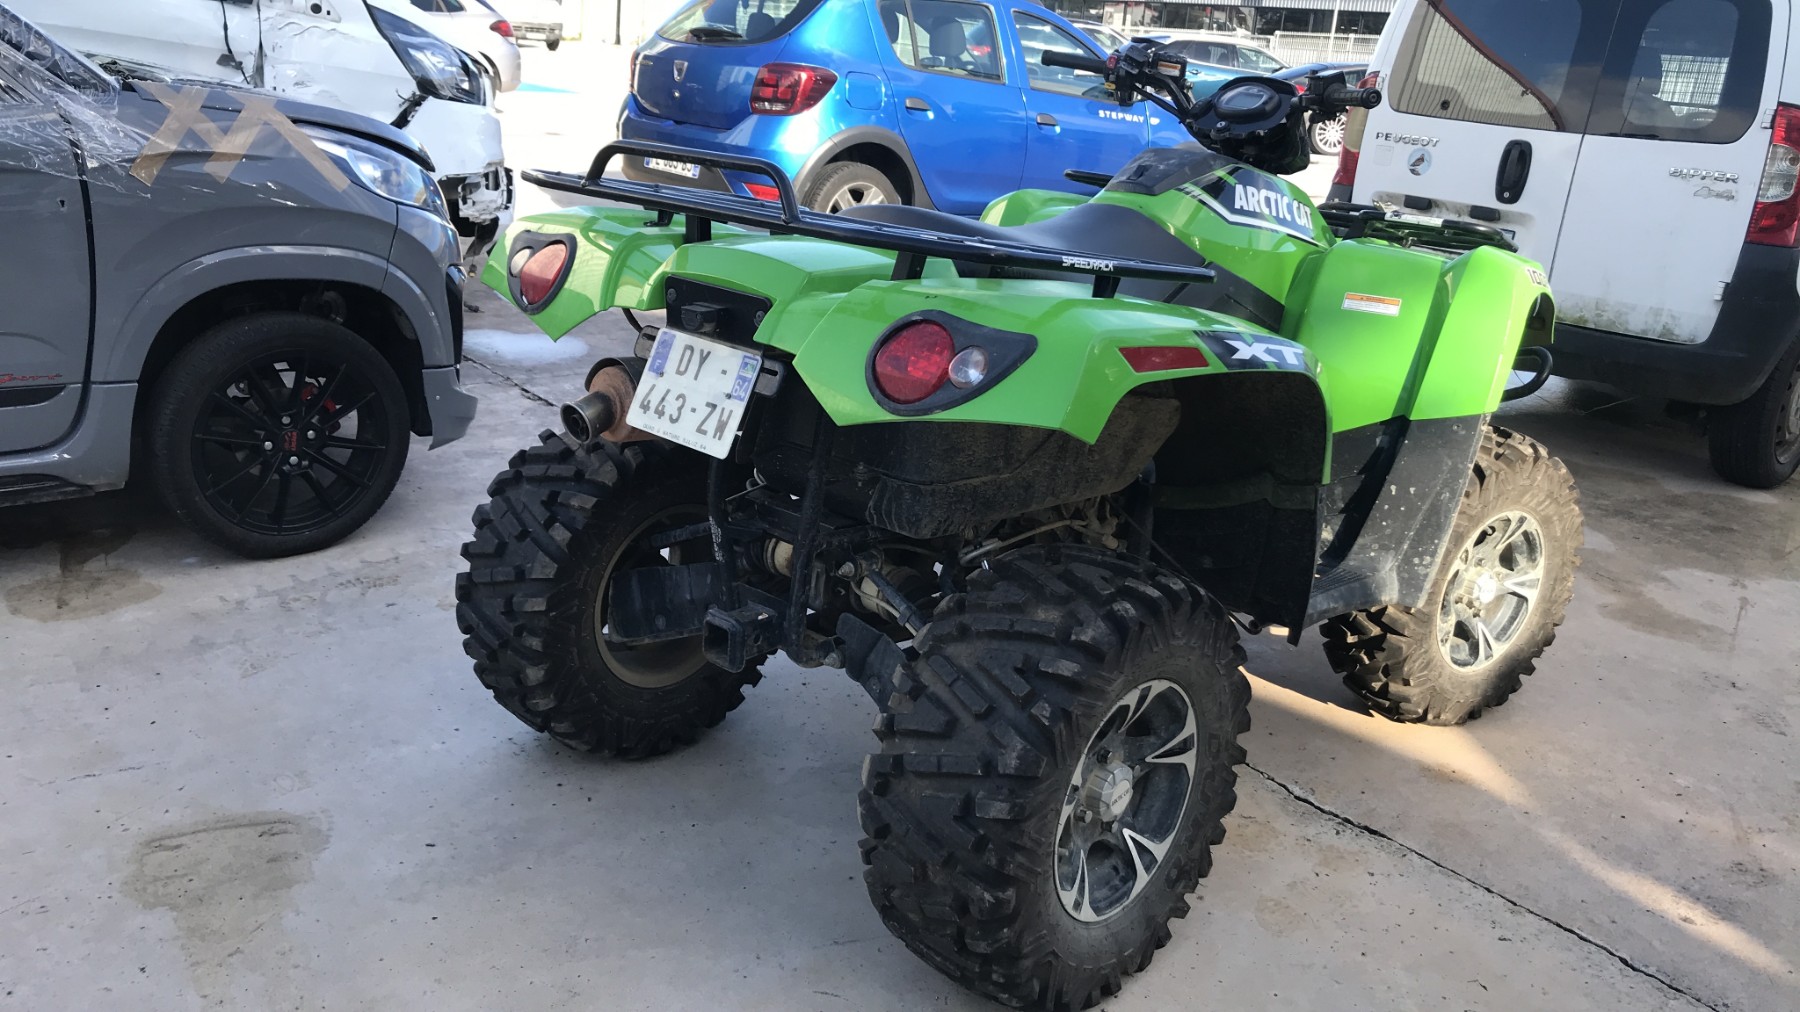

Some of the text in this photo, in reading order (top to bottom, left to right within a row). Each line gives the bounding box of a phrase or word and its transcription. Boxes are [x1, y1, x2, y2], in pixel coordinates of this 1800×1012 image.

[1098, 109, 1144, 123] STEPWAY
[1375, 131, 1440, 147] PEUGEOT
[1669, 167, 1739, 184] BIPPER
[1234, 183, 1313, 230] ARCTIC CAT
[1061, 256, 1114, 271] SPEEDRACK
[1223, 339, 1304, 366] XT
[655, 359, 662, 370] F
[675, 344, 711, 381] DY
[732, 379, 748, 399] 64
[639, 384, 733, 441] 443-ZW
